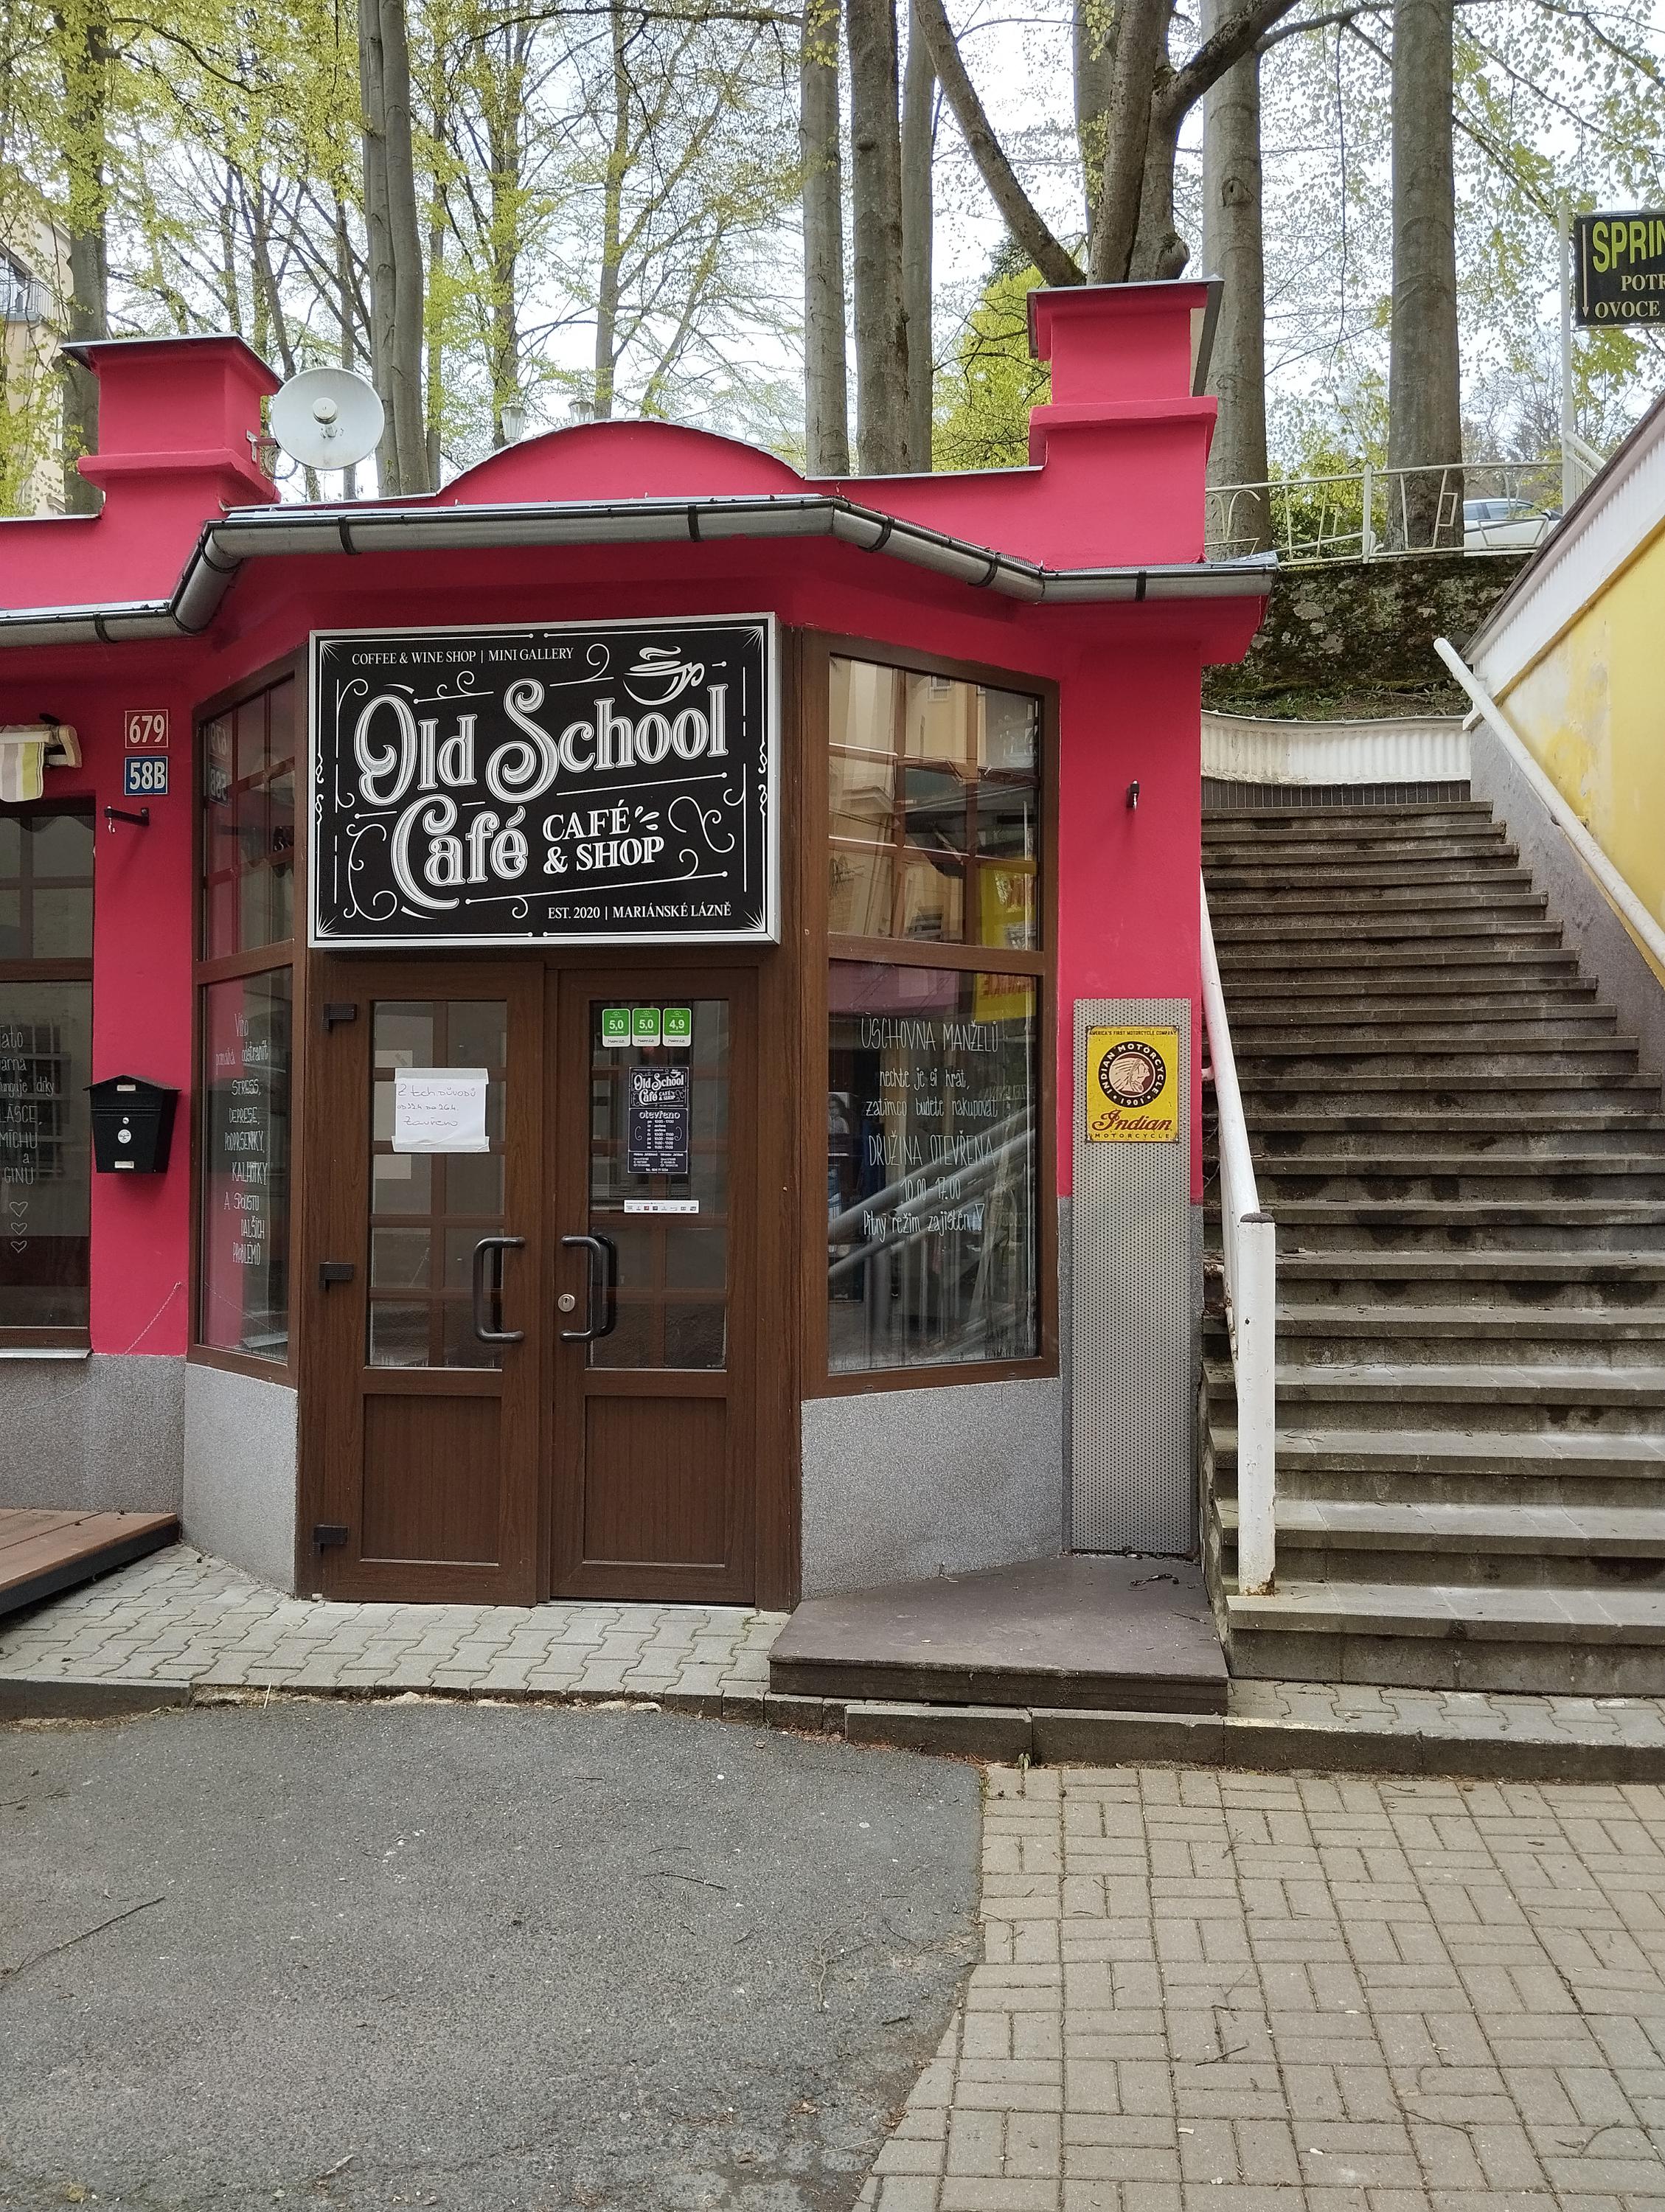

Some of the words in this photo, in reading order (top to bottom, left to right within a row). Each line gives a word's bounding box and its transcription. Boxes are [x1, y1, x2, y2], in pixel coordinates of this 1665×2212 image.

[1594, 300, 1661, 319] OVOCE
[352, 652, 397, 665] COFFEE
[399, 652, 409, 664] &
[411, 651, 444, 664] WINE
[446, 650, 476, 663] SHOP
[488, 649, 518, 662] MINI
[519, 647, 574, 661] GALLERY
[129, 714, 165, 744] 679
[353, 694, 478, 806] Old
[485, 678, 729, 803] School
[129, 761, 166, 790] 58B
[542, 799, 631, 842] CAFÉ
[391, 793, 529, 910] Café
[542, 846, 569, 875] &
[575, 835, 665, 872] SHOP
[548, 907, 571, 919] EST.
[573, 906, 601, 919] 2020
[612, 902, 689, 918] MARIÁNSKÉ
[690, 900, 732, 917] LÁZNĚ
[608, 1019, 625, 1031] 5,0
[639, 1019, 654, 1030] 5,0
[668, 1019, 685, 1031] 4,9
[942, 1019, 998, 1053] MANŽELŮ
[633, 1074, 651, 1091] Old
[651, 1073, 684, 1091] School
[1100, 1051, 1116, 1094] INDIAN
[1117, 1043, 1164, 1095] MOTORCYCLE
[1120, 1097, 1145, 1106] 1901
[1092, 1108, 1172, 1131] Indian
[868, 1130, 923, 1166] DRUŽINA
[930, 1130, 996, 1166] OTEVŘENA
